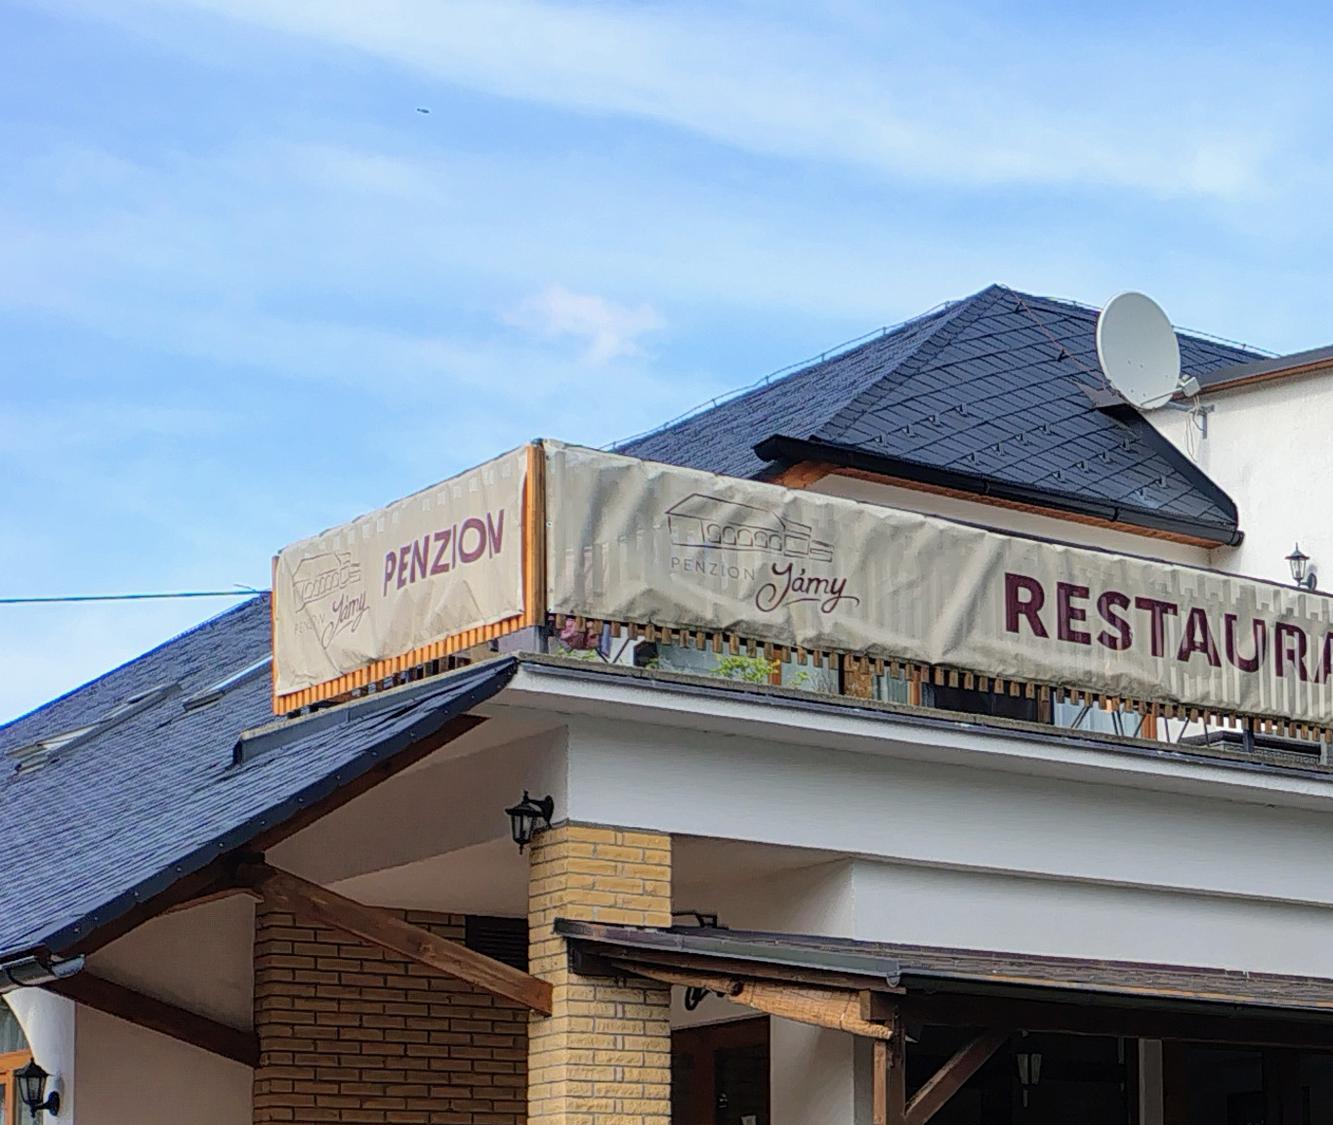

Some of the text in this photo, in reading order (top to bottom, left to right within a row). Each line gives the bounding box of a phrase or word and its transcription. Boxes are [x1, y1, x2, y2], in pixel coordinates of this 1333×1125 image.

[383, 509, 504, 597] PENZION
[671, 556, 755, 580] PENZION
[755, 563, 859, 613] Jámy
